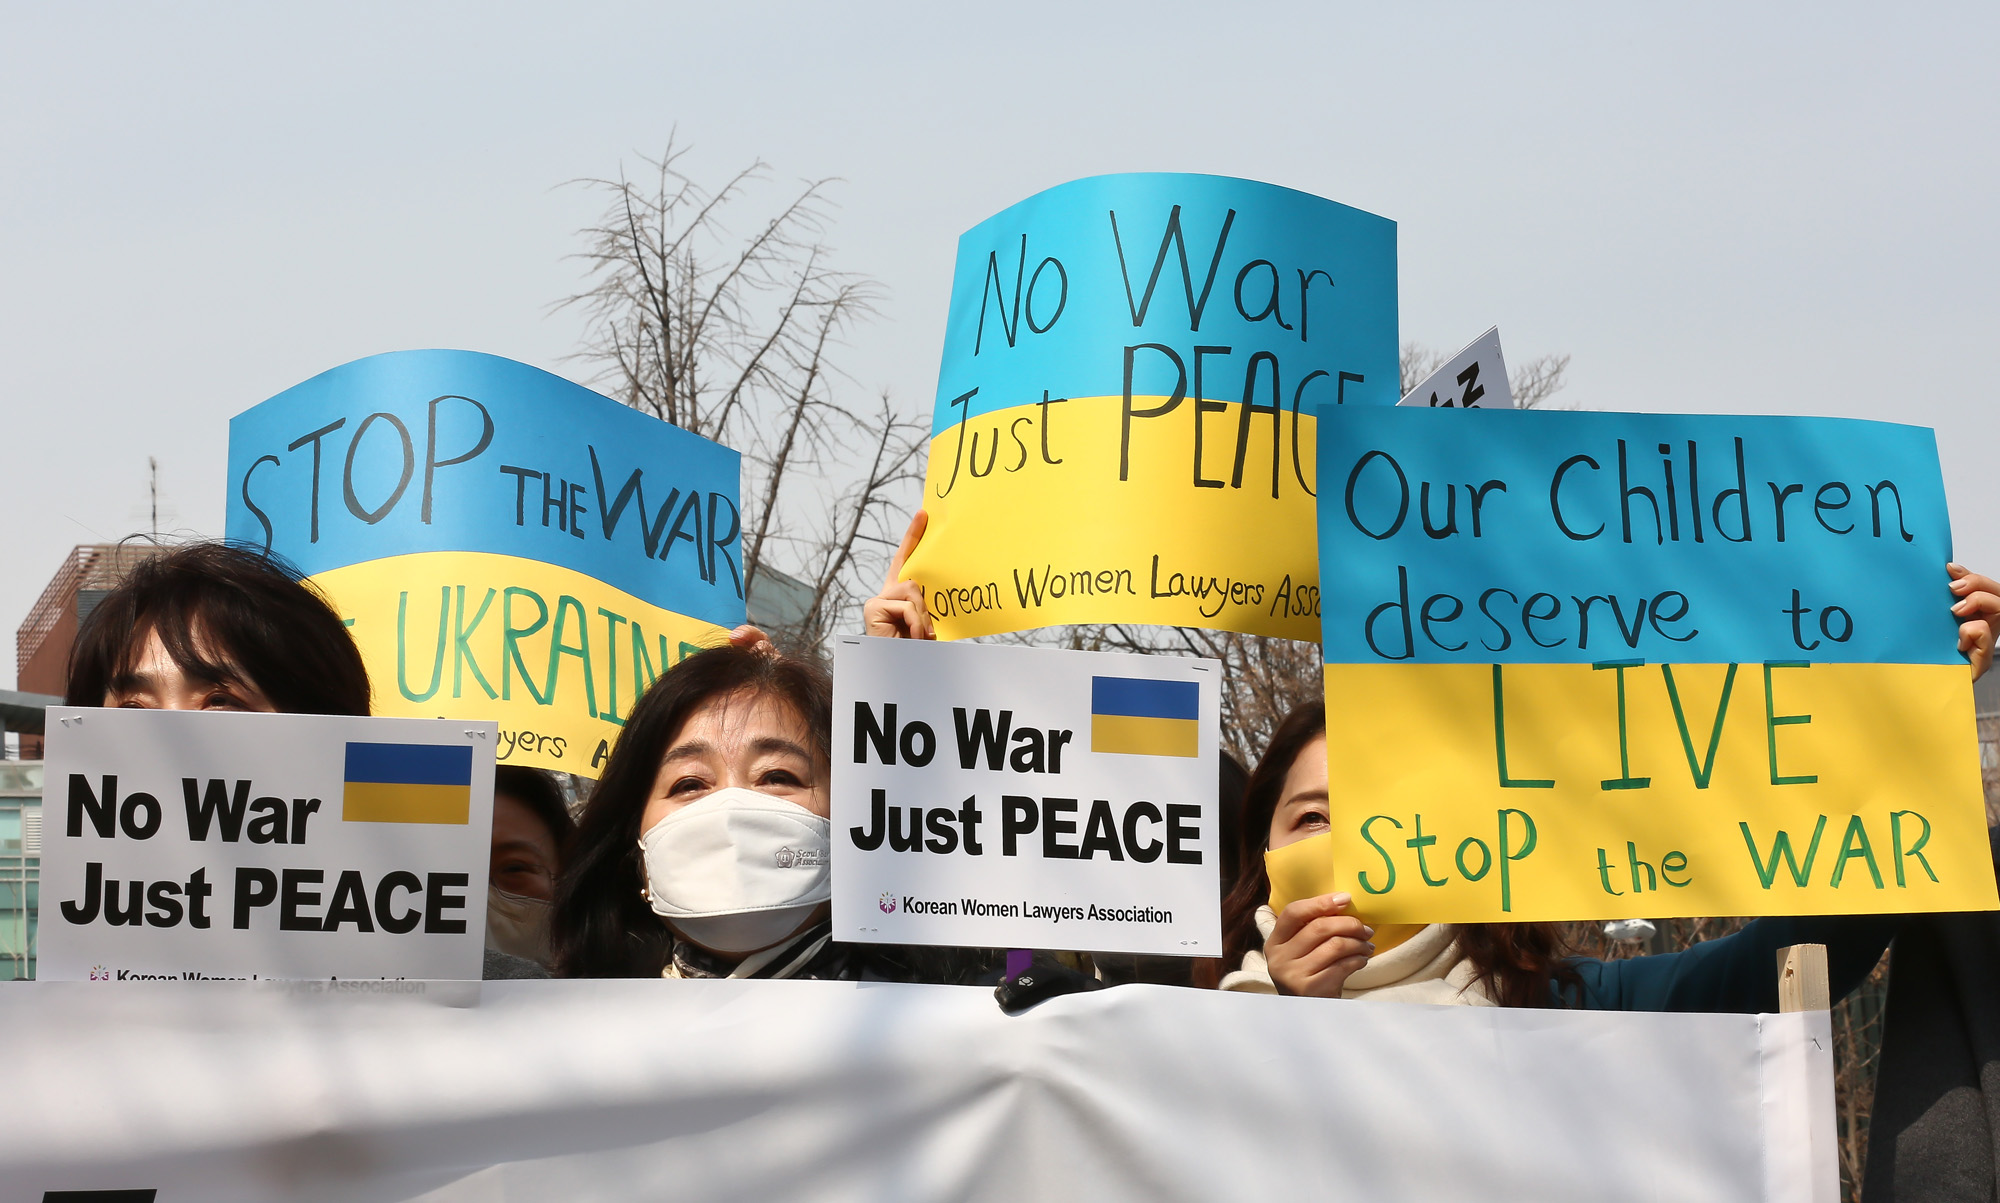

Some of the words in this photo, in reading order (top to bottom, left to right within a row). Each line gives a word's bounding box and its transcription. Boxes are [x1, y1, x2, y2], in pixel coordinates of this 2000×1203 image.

[975, 234, 1068, 357] No
[1109, 204, 1336, 343] War
[936, 387, 1068, 500] Just
[1119, 343, 1365, 500] PEAC
[242, 395, 495, 558] STOP
[501, 464, 588, 540] THE
[588, 444, 744, 601] WAR
[1344, 450, 1507, 541] Our
[1549, 436, 1915, 546] Children
[1013, 564, 1137, 608] Women
[1150, 554, 1264, 618] Lawyers
[1364, 565, 1699, 660] deserve
[1782, 588, 1854, 651] to
[398, 584, 705, 728] UKRAIN
[853, 701, 937, 768] No
[952, 707, 1073, 775] War
[1492, 657, 1819, 791] LIVE
[66, 773, 162, 841] No
[181, 777, 322, 845] War
[849, 788, 983, 856] Just
[1001, 795, 1203, 865] PEACE
[1597, 841, 1692, 896] the
[1739, 810, 1939, 890] WAR
[60, 862, 213, 930] Just
[232, 866, 470, 935] PEACE
[903, 896, 957, 916] Korean
[960, 898, 1019, 918] Women
[1023, 900, 1084, 924] Lawyers
[1087, 904, 1173, 924] Association
